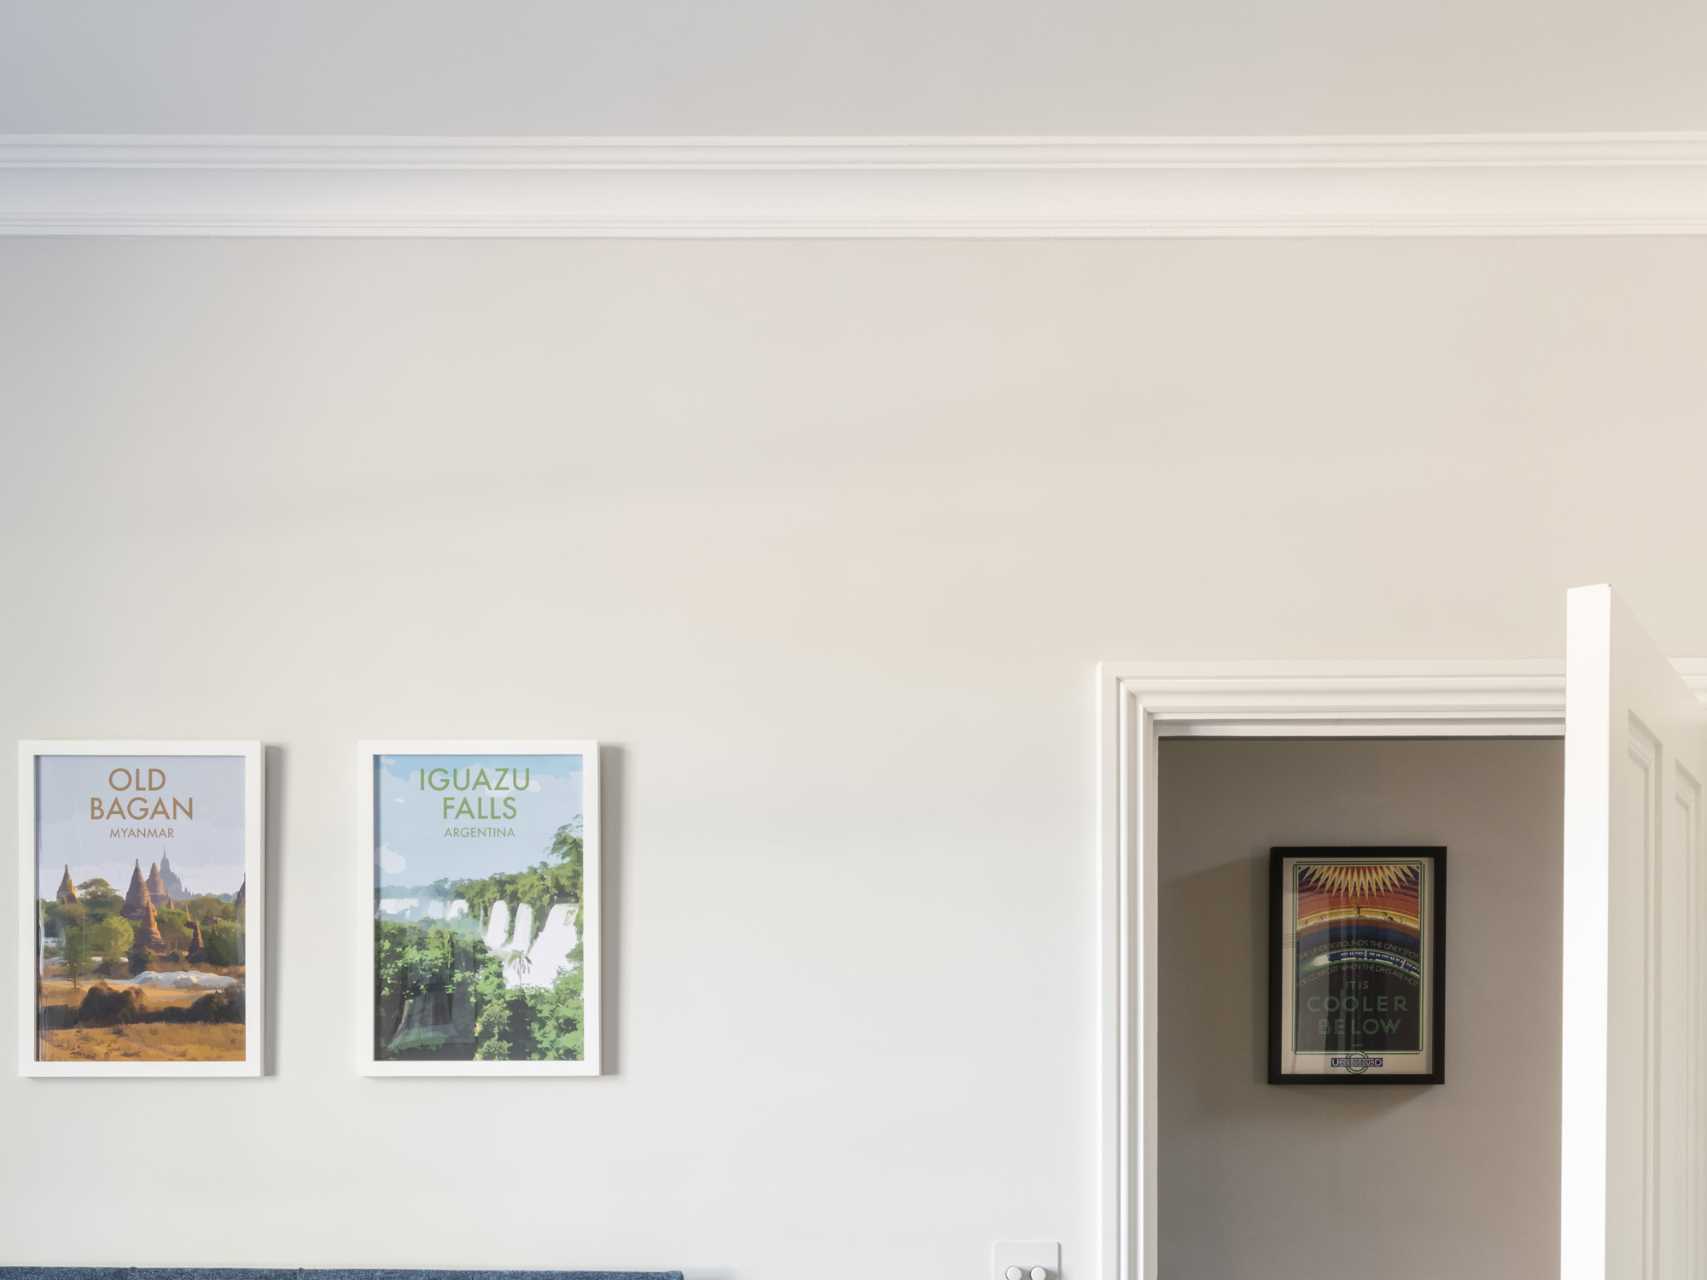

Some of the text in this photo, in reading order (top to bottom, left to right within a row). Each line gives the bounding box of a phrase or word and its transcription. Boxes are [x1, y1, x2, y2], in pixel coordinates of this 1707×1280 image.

[108, 768, 166, 791] OLD
[419, 768, 530, 792] IGUAZU
[90, 797, 193, 820] BAGAN
[442, 797, 517, 820] FALLS
[110, 827, 174, 838] MYANMAR
[444, 827, 515, 838] ARGENTINA
[1307, 996, 1408, 1012] COOLER
[1318, 1018, 1401, 1034] BELOW
